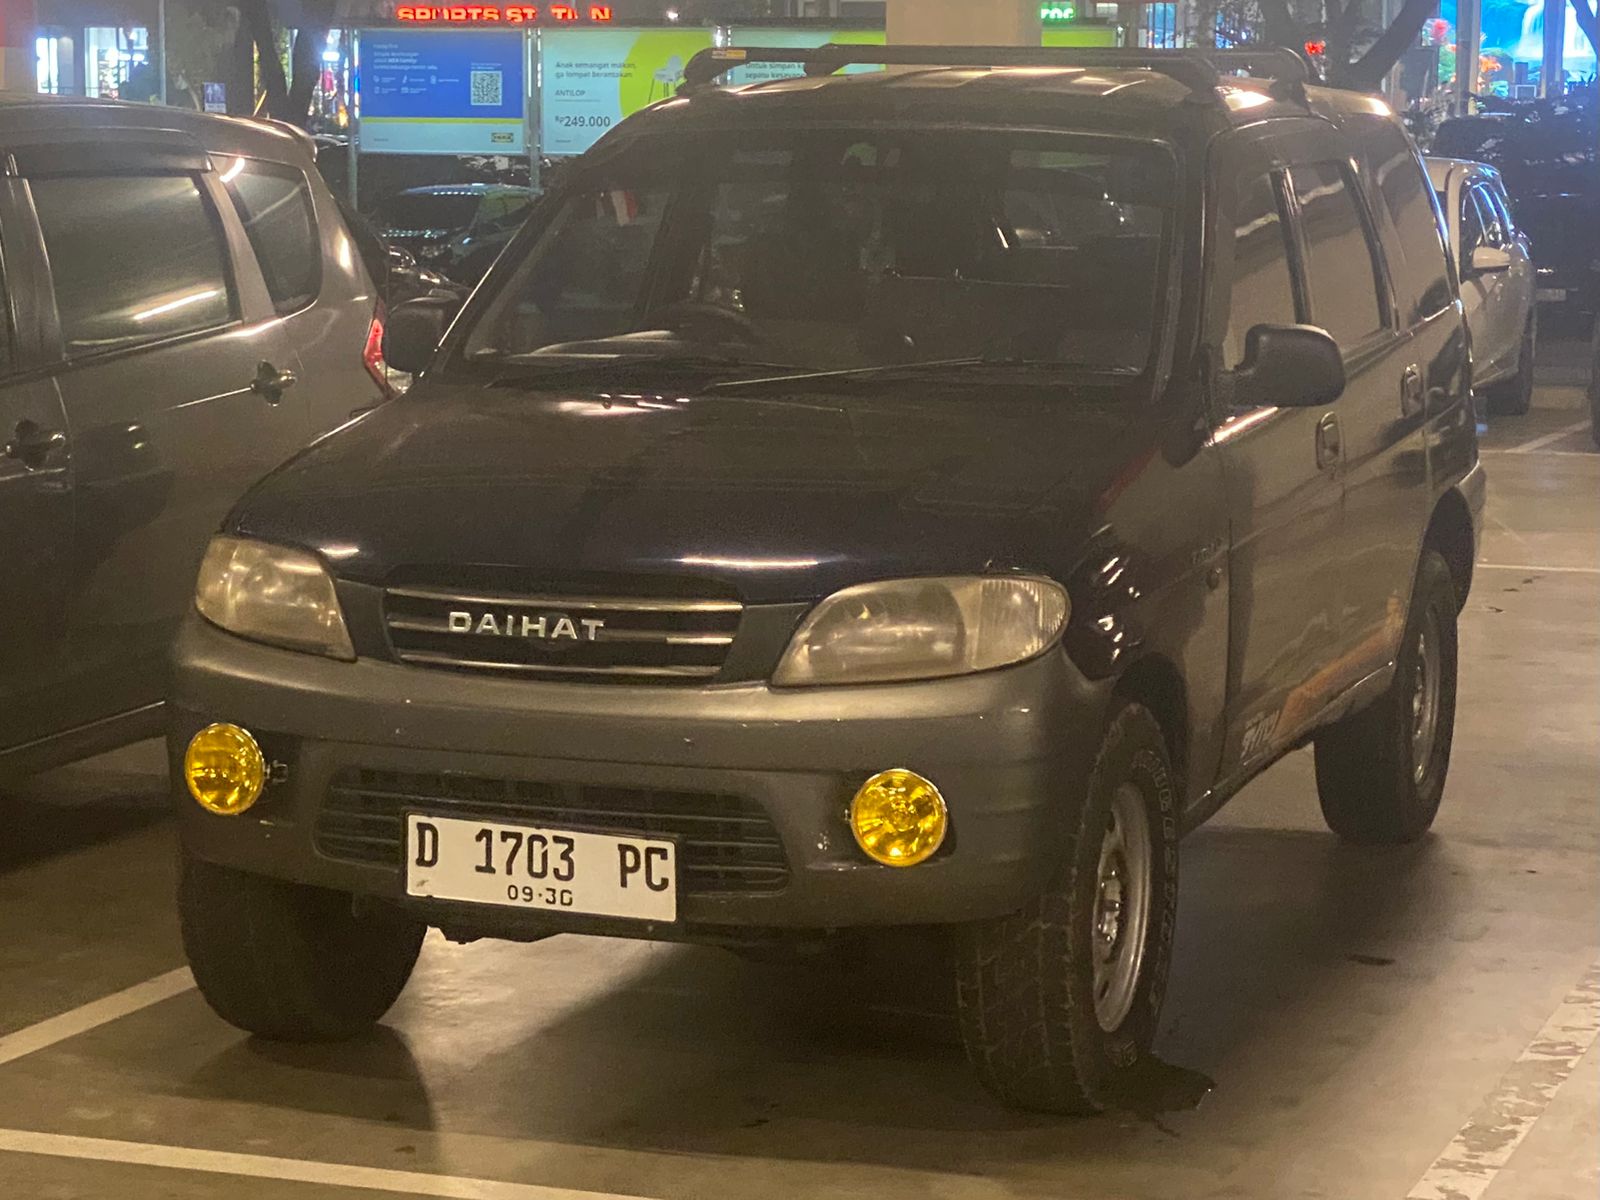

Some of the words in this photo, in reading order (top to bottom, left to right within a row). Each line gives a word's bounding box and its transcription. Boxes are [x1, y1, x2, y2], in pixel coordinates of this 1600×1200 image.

[575, 62, 609, 70] semangat
[566, 71, 591, 79] lompat
[555, 89, 586, 97] ANTILOP
[449, 611, 604, 641] DAIHAT
[415, 821, 439, 868] D
[474, 828, 575, 882] 1703
[617, 843, 669, 892] PC
